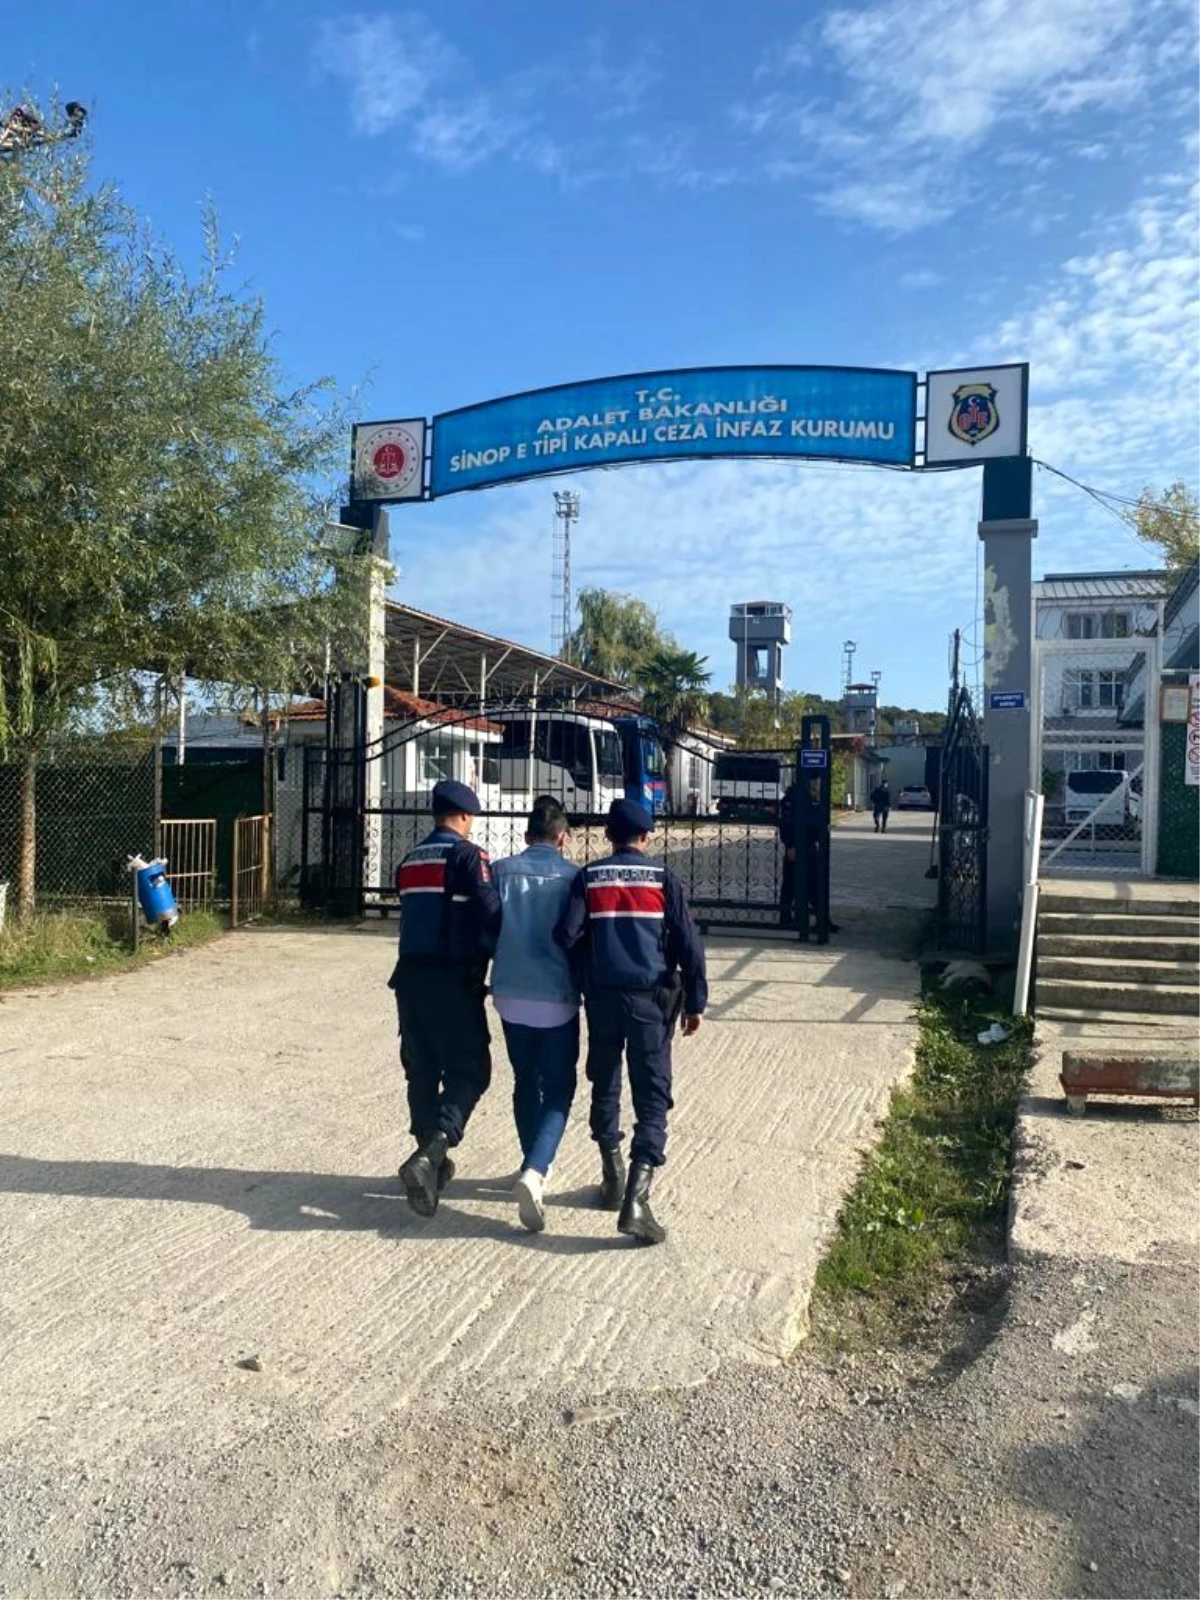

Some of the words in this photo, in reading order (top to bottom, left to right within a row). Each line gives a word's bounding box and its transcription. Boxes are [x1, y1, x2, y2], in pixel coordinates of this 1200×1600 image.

[635, 388, 681, 404] T.C.
[537, 410, 630, 433] ADALET
[638, 395, 788, 421] BAKANLIĞI
[450, 447, 510, 472] SİNOP
[517, 442, 527, 459] E
[533, 432, 568, 456] TİPİ
[574, 428, 646, 451] KAPALI
[654, 422, 708, 442] CEZA
[716, 415, 783, 438] İNFAZ
[790, 419, 895, 440] KURUMU
[596, 868, 656, 882] JANDARMA
